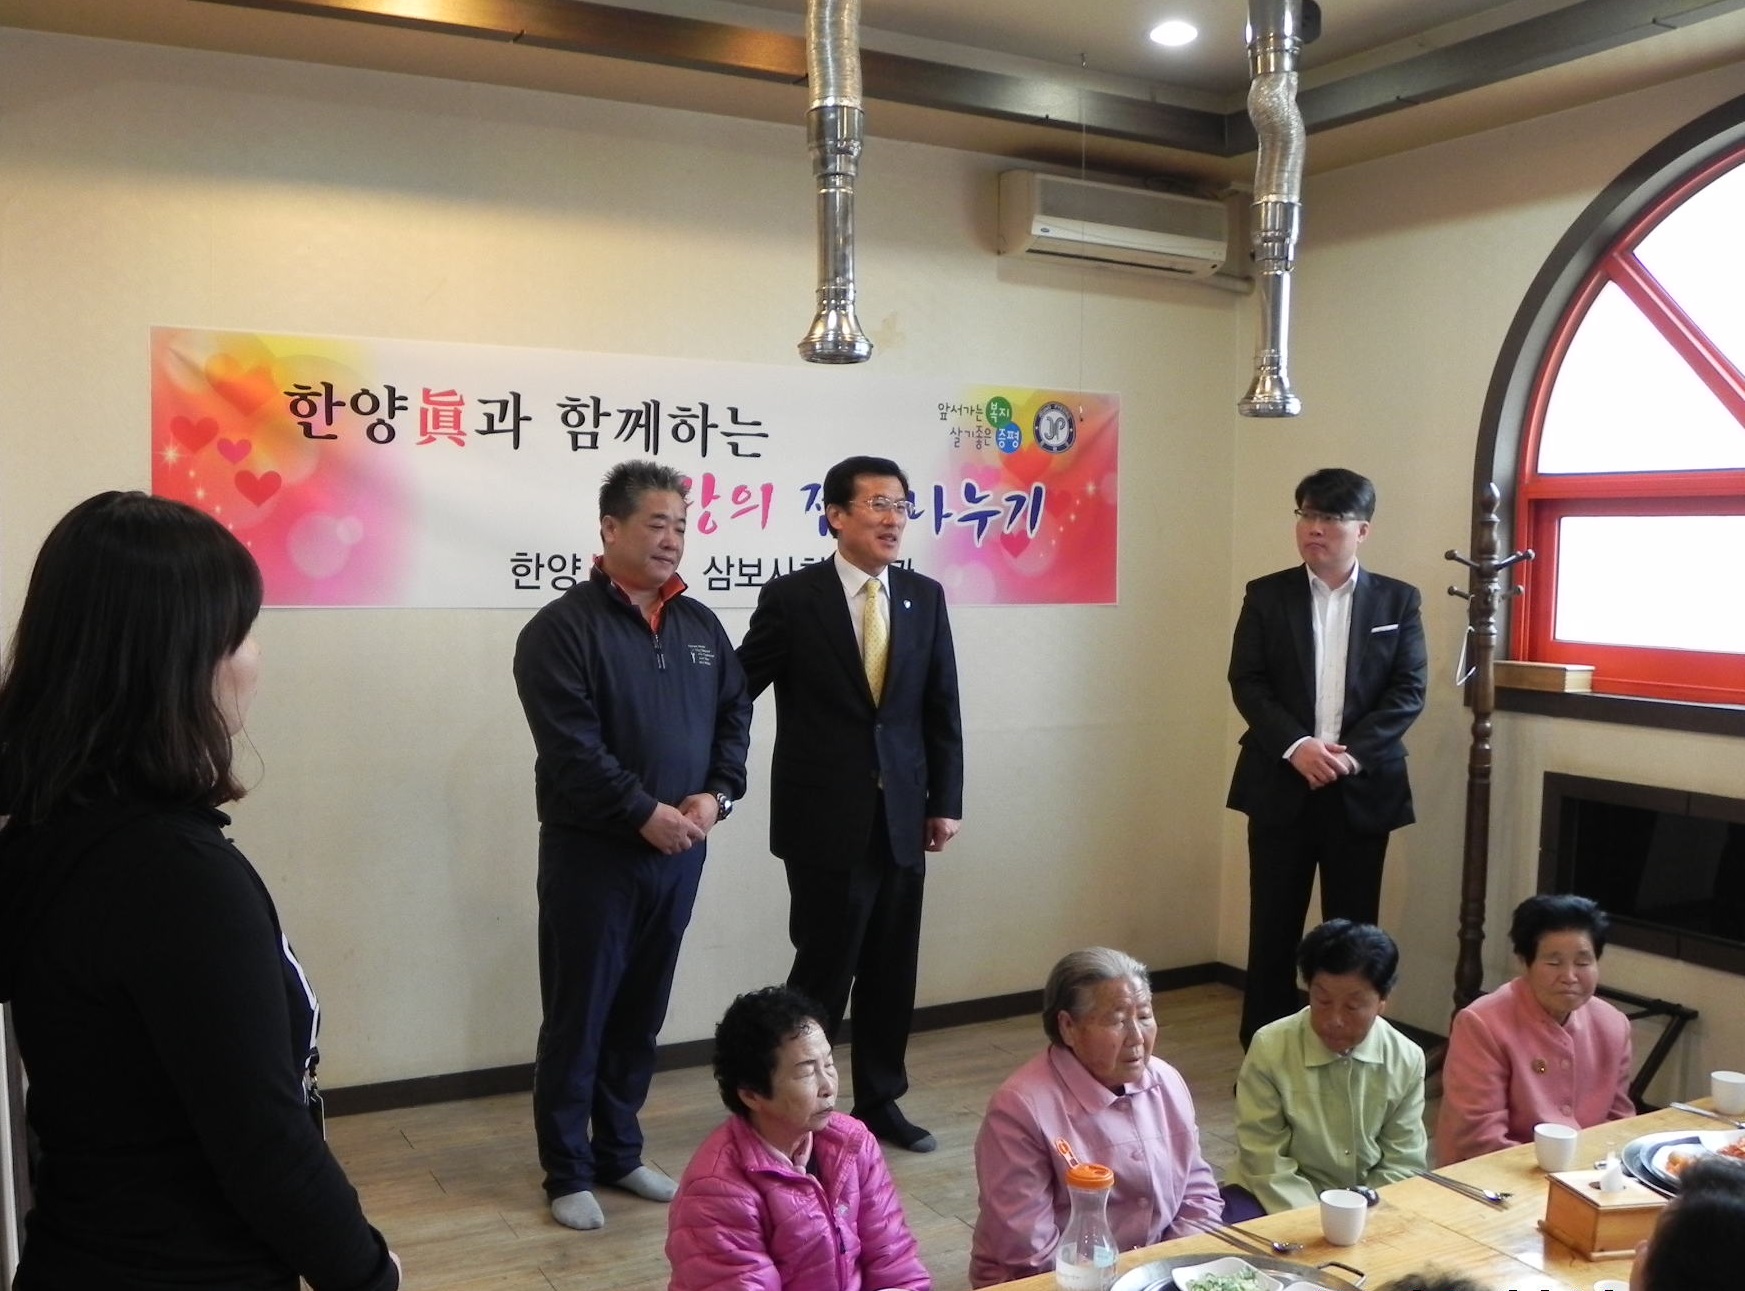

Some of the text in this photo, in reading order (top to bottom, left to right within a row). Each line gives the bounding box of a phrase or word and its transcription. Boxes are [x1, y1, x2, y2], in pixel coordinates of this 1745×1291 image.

[284, 381, 769, 458] 한양眞과 함께하는
[937, 402, 984, 422] 앞서가는
[989, 401, 1010, 423] 복지
[949, 425, 992, 450] 살기좋은
[997, 428, 1020, 449] 증평
[682, 472, 774, 535] 랑의
[906, 482, 1045, 543] 나누기
[510, 552, 594, 591] 한양
